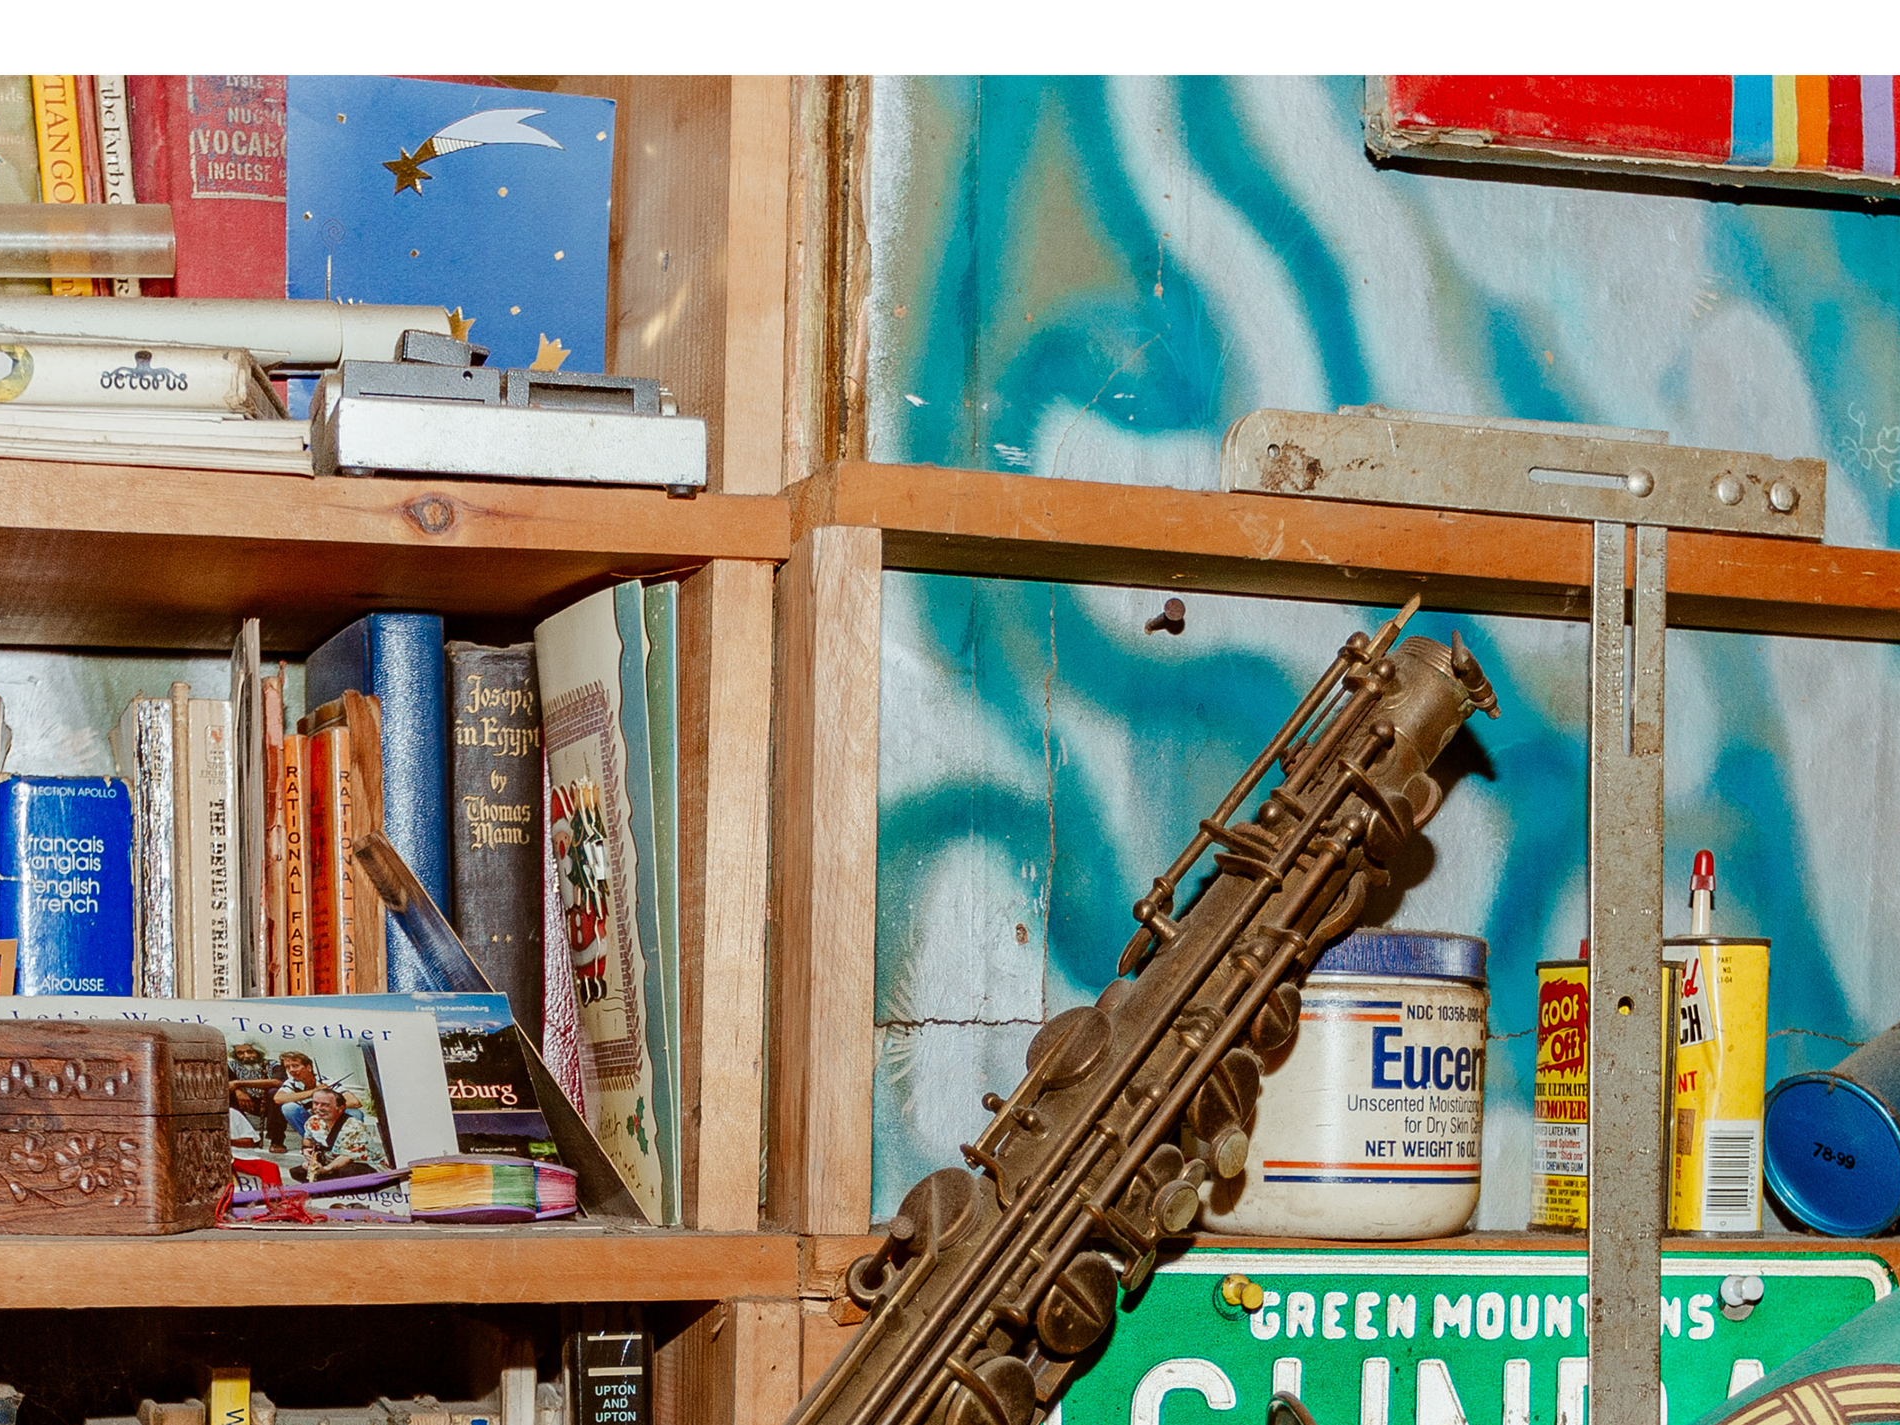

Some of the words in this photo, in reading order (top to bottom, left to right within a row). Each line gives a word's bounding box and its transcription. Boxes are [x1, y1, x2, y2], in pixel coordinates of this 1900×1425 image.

[464, 674, 535, 714] Joseph
[479, 715, 542, 759] Egypt
[77, 786, 118, 800] APOLLO
[489, 770, 509, 795] by
[209, 799, 226, 837] THE
[462, 794, 532, 825] Thomas
[286, 766, 302, 895] RATIONAL
[339, 771, 354, 901] RATIONAL
[468, 820, 531, 852] Mann
[26, 834, 105, 855] français
[33, 877, 101, 900] english
[35, 896, 99, 914] french
[1406, 1004, 1434, 1021] NDC
[1541, 993, 1580, 1030] GOOF
[231, 1016, 393, 1042] Together
[1550, 1027, 1582, 1064] OFF
[1347, 1093, 1425, 1113] Unscented
[1534, 1099, 1588, 1121] REMOVER
[1404, 1117, 1423, 1134] for
[1426, 1116, 1448, 1138] Dry
[1450, 1117, 1470, 1134] Skin
[1365, 1140, 1397, 1158] NET
[1402, 1140, 1454, 1158] WEIGHT
[1455, 1142, 1467, 1158] 16
[1811, 1141, 1857, 1171] 78-99
[1250, 1290, 1417, 1343] GREEN
[594, 1384, 637, 1398] UPTON
[594, 1410, 638, 1423] UPTON
[602, 1398, 630, 1411] AND
